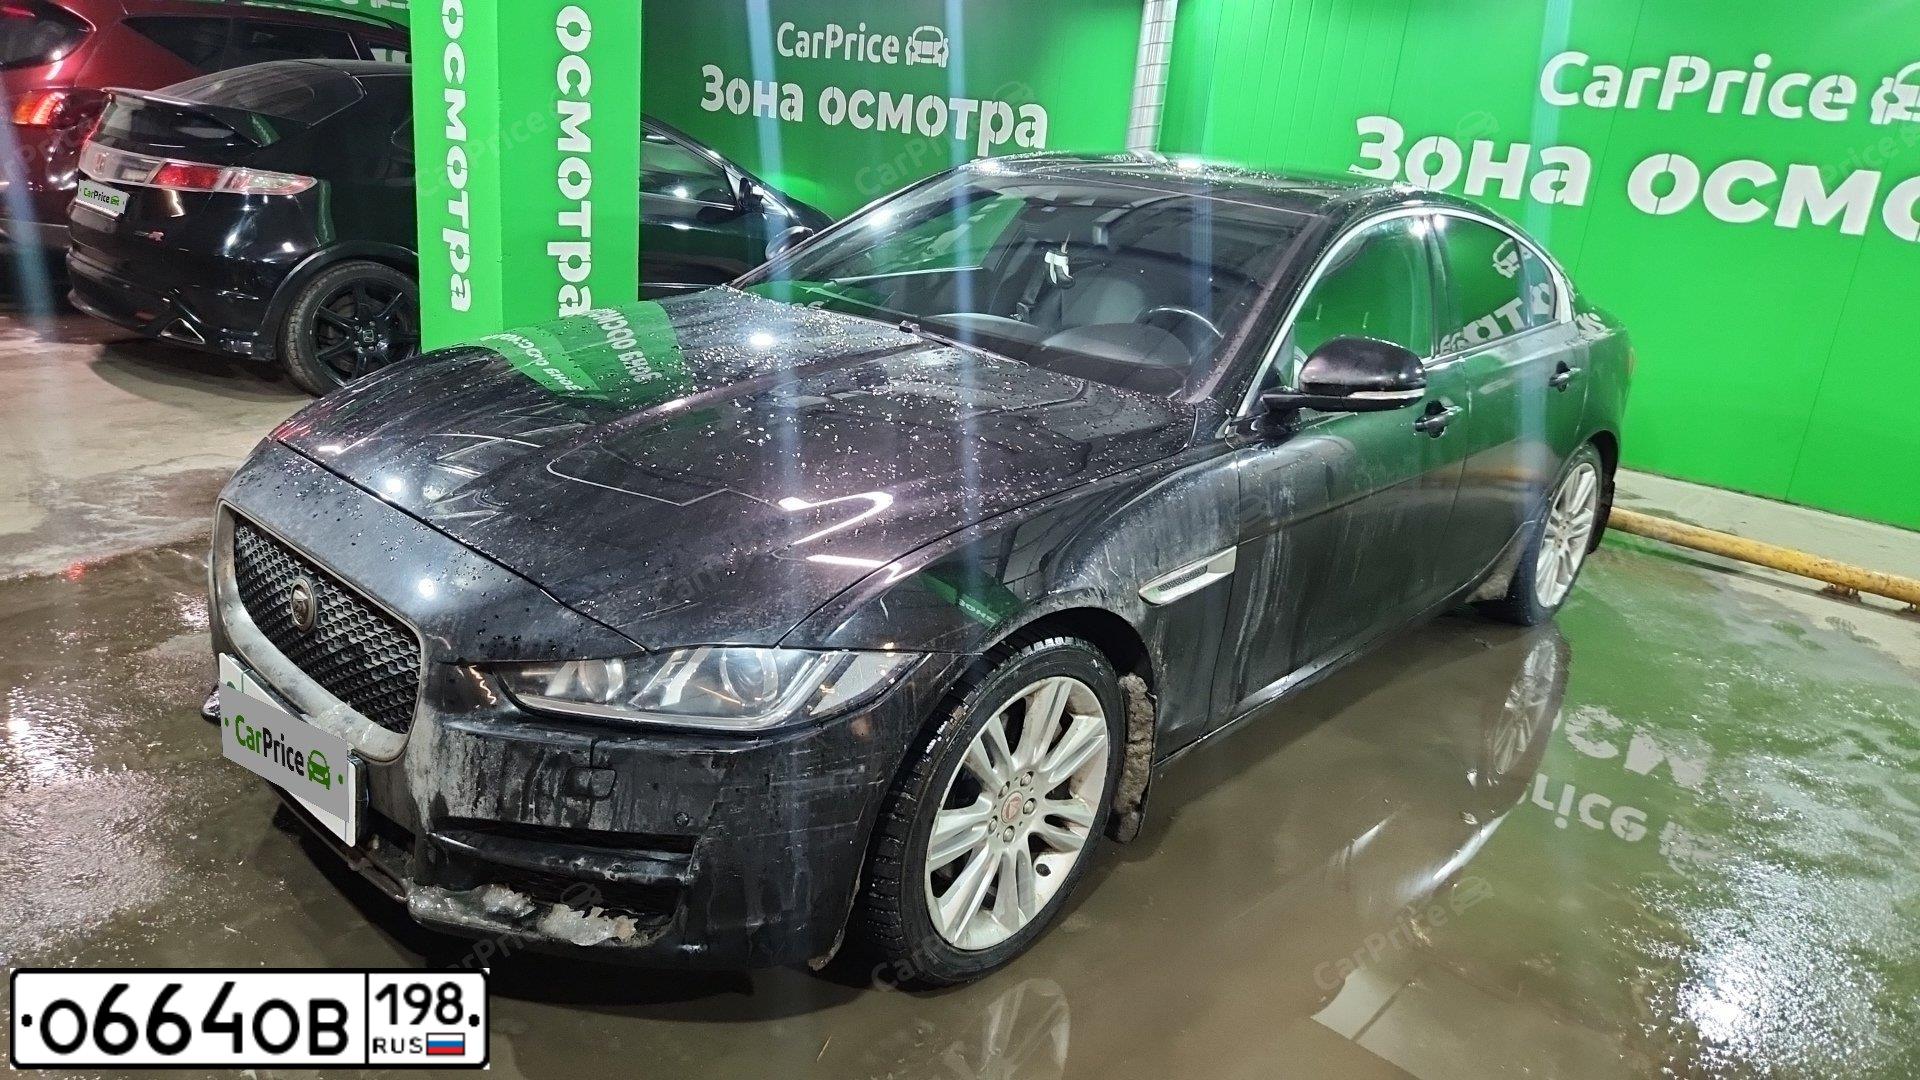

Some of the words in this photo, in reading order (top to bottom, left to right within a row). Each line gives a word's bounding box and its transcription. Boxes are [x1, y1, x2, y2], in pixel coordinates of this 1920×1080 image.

[777, 21, 899, 65] CarPrice
[1539, 51, 1858, 122] CarPrice
[441, 0, 472, 313] осмотра
[700, 64, 804, 122] Зона
[818, 86, 1048, 157] осмотра
[547, 5, 592, 318] осмотра
[1346, 115, 1592, 206] Зона
